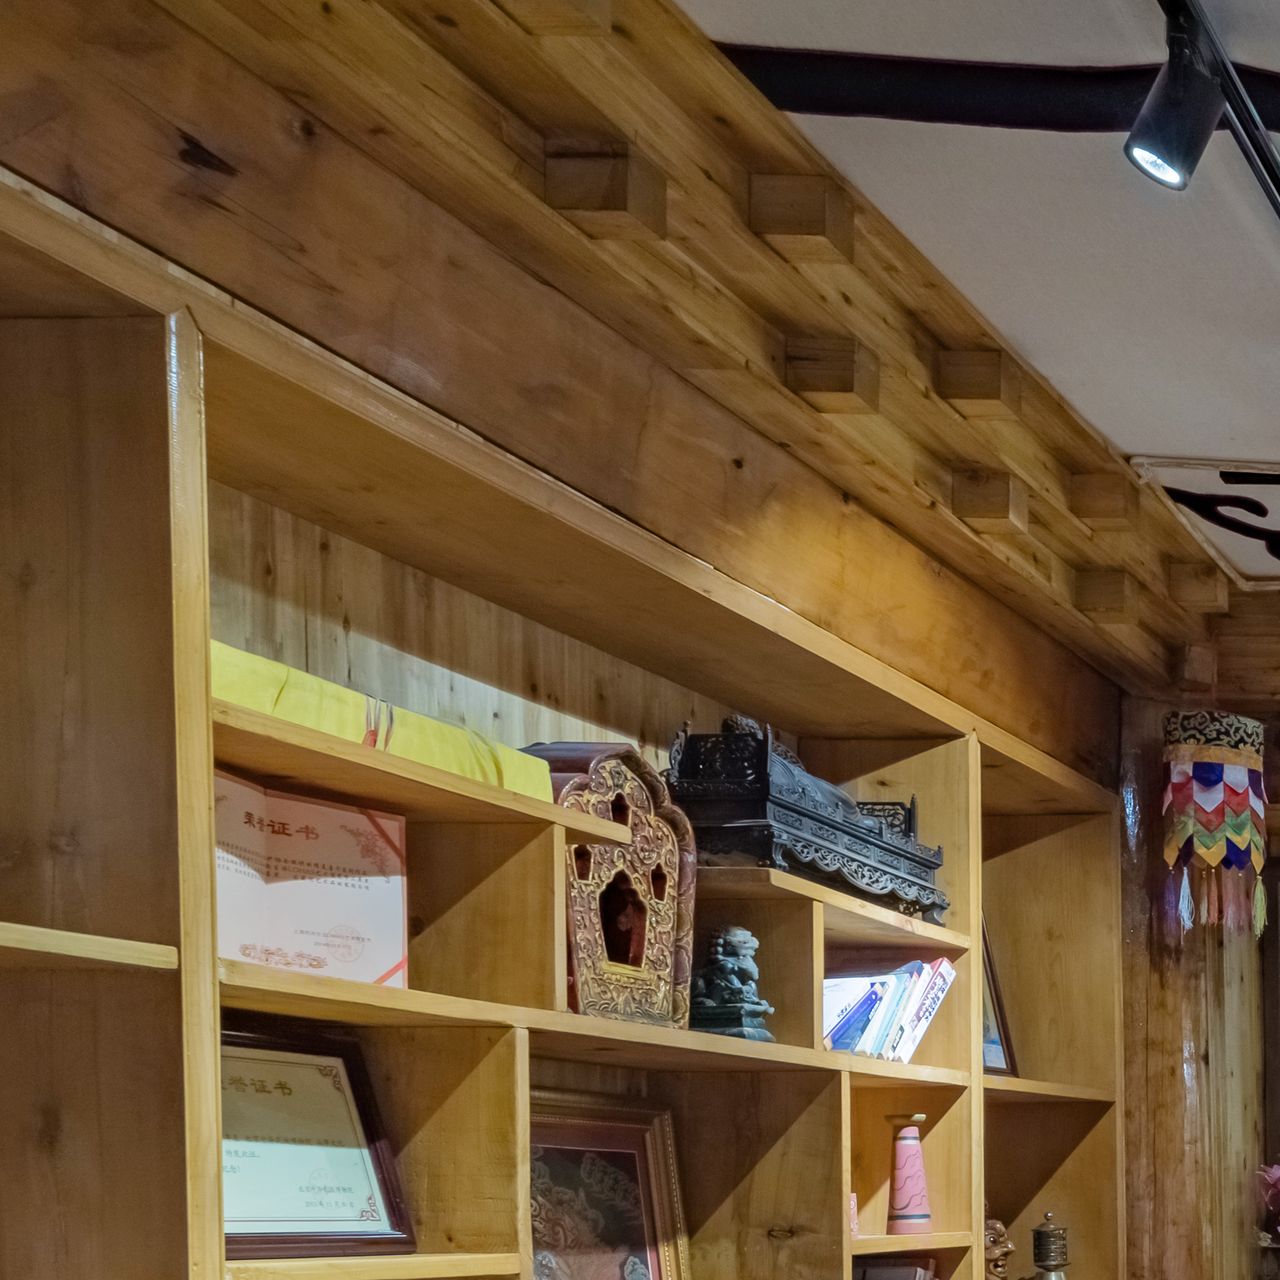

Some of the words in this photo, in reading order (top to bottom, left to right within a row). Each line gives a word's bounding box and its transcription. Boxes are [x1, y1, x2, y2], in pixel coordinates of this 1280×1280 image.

[242, 811, 320, 840] 荣誉证书
[222, 1075, 293, 1096] 誉证书
